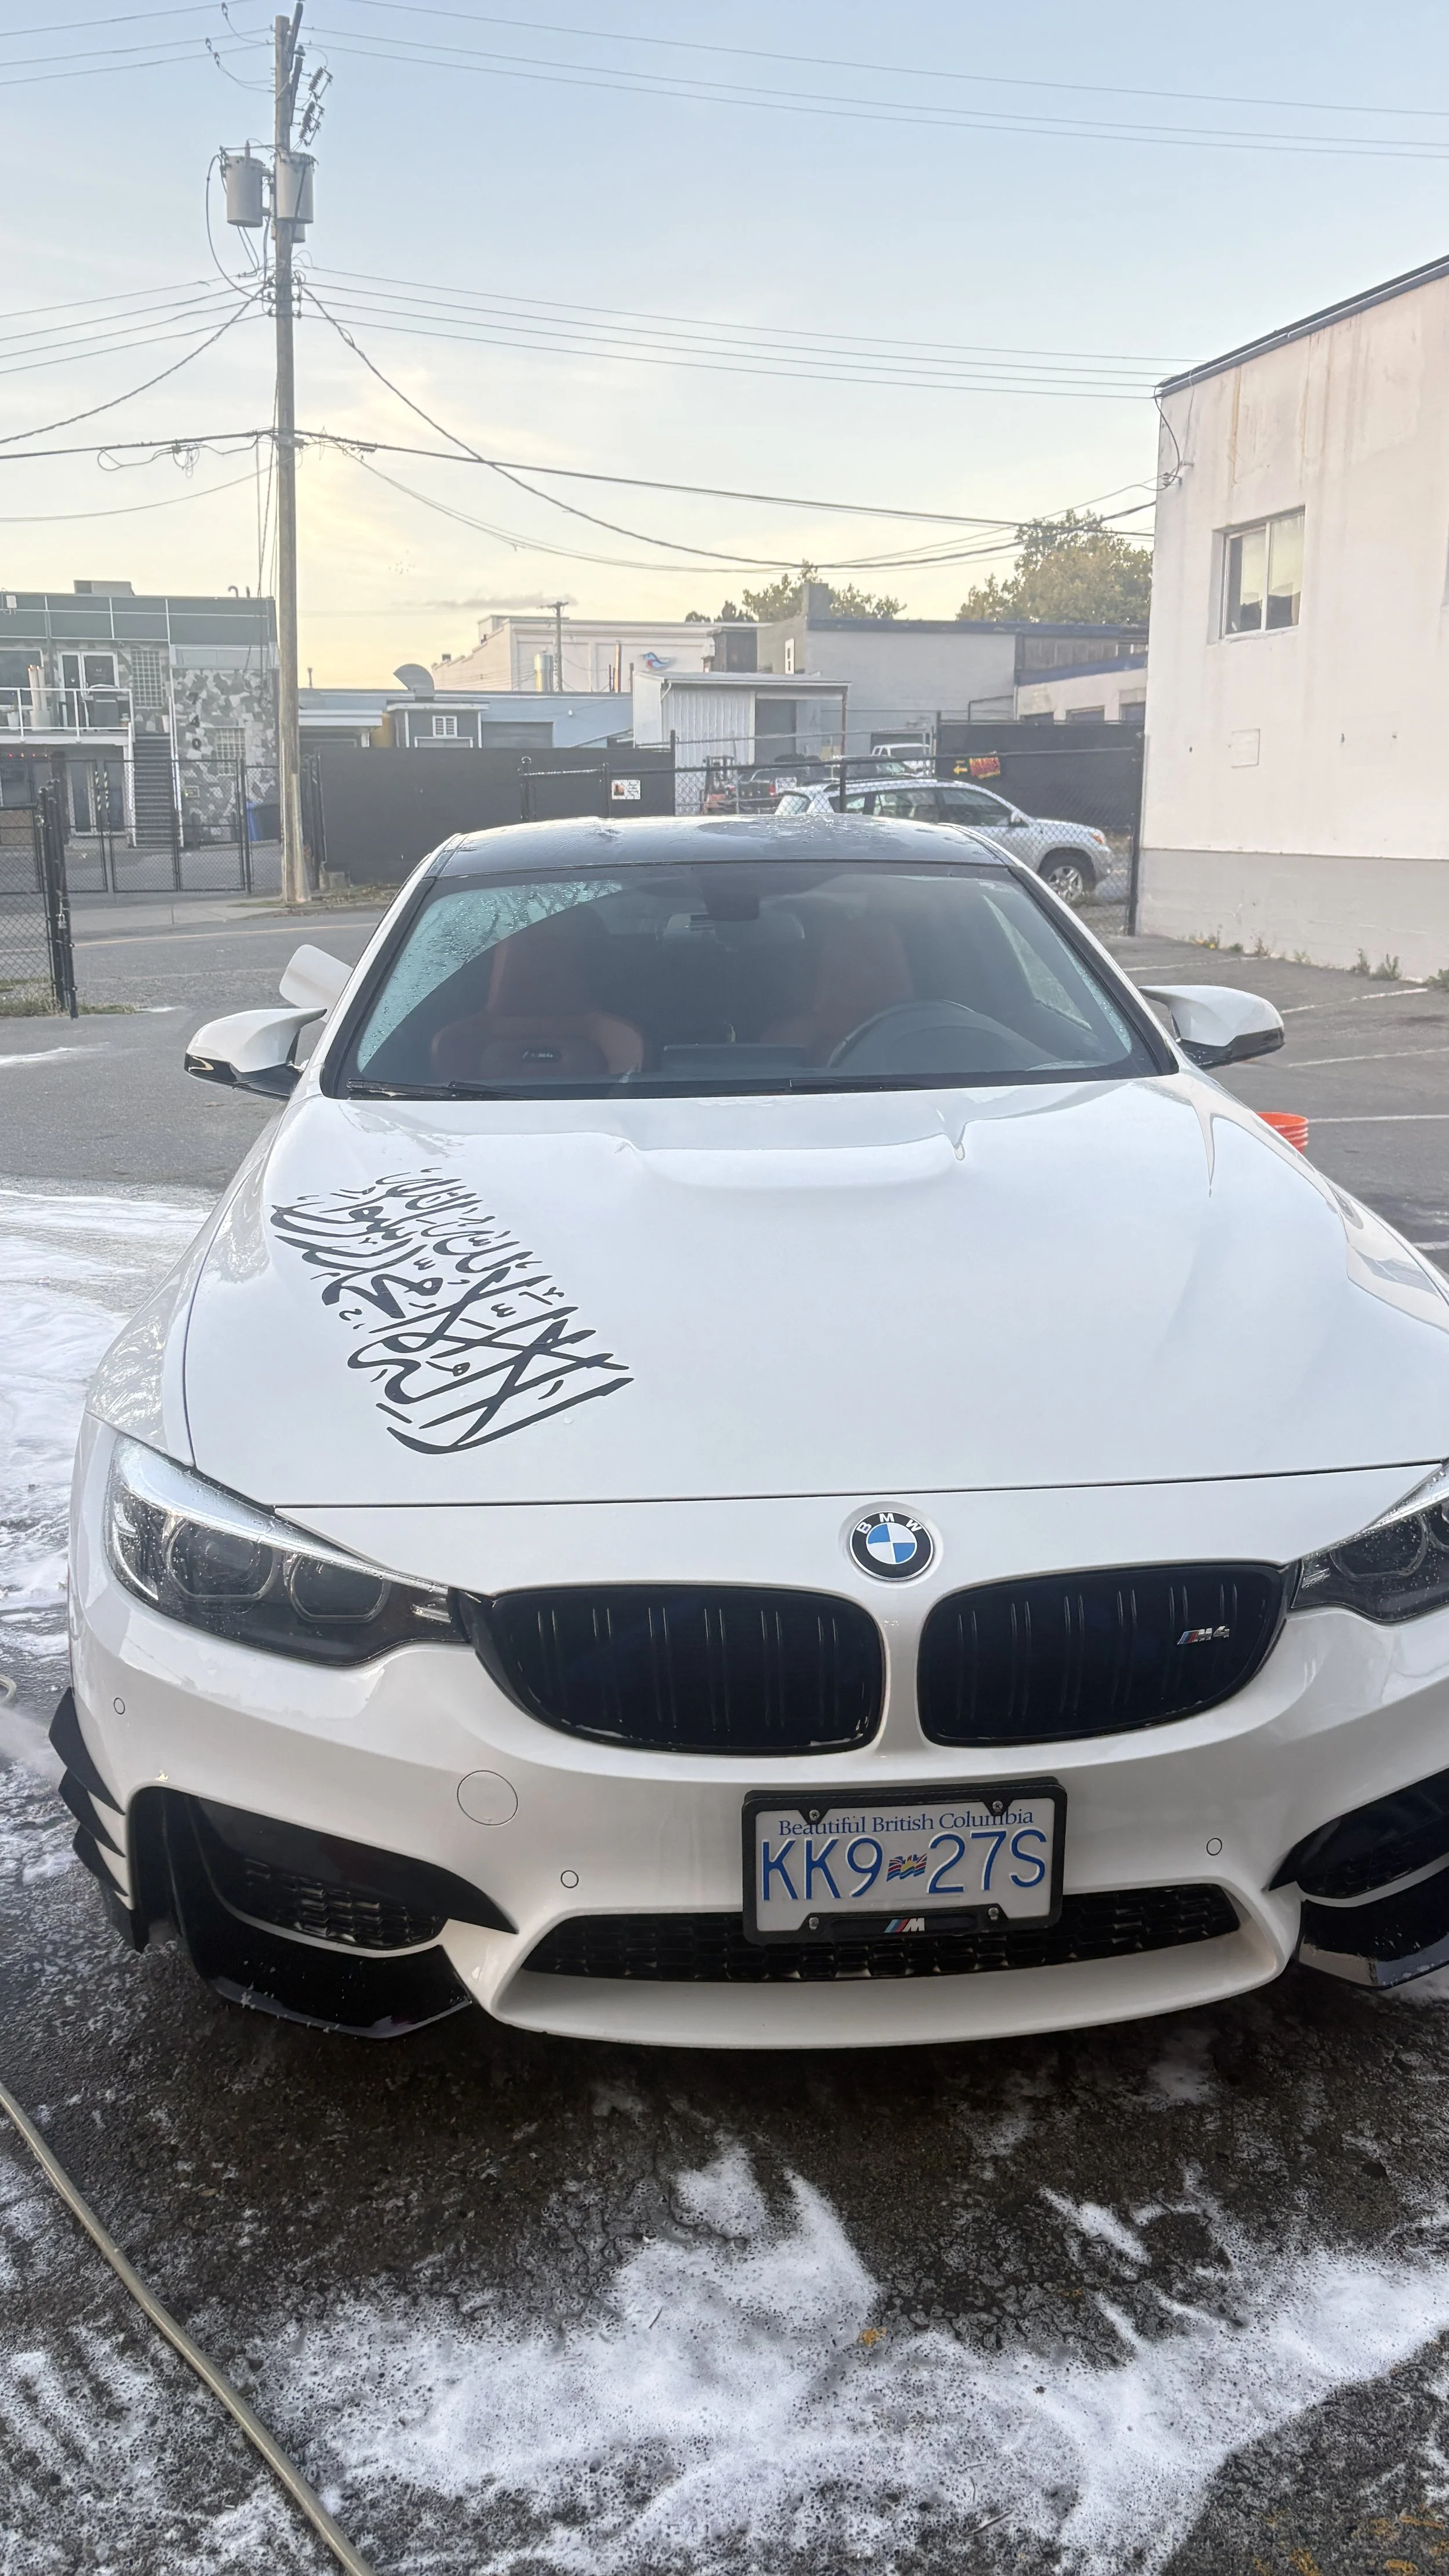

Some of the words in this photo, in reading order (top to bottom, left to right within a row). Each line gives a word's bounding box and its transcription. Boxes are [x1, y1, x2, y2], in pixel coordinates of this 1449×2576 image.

[856, 1513, 922, 1534] BMW
[778, 1815, 867, 1836] Beautiful
[872, 1813, 934, 1832] British
[938, 1808, 1034, 1829] Columbia
[762, 1838, 884, 1901] KK9
[927, 1830, 1047, 1894] 27S
